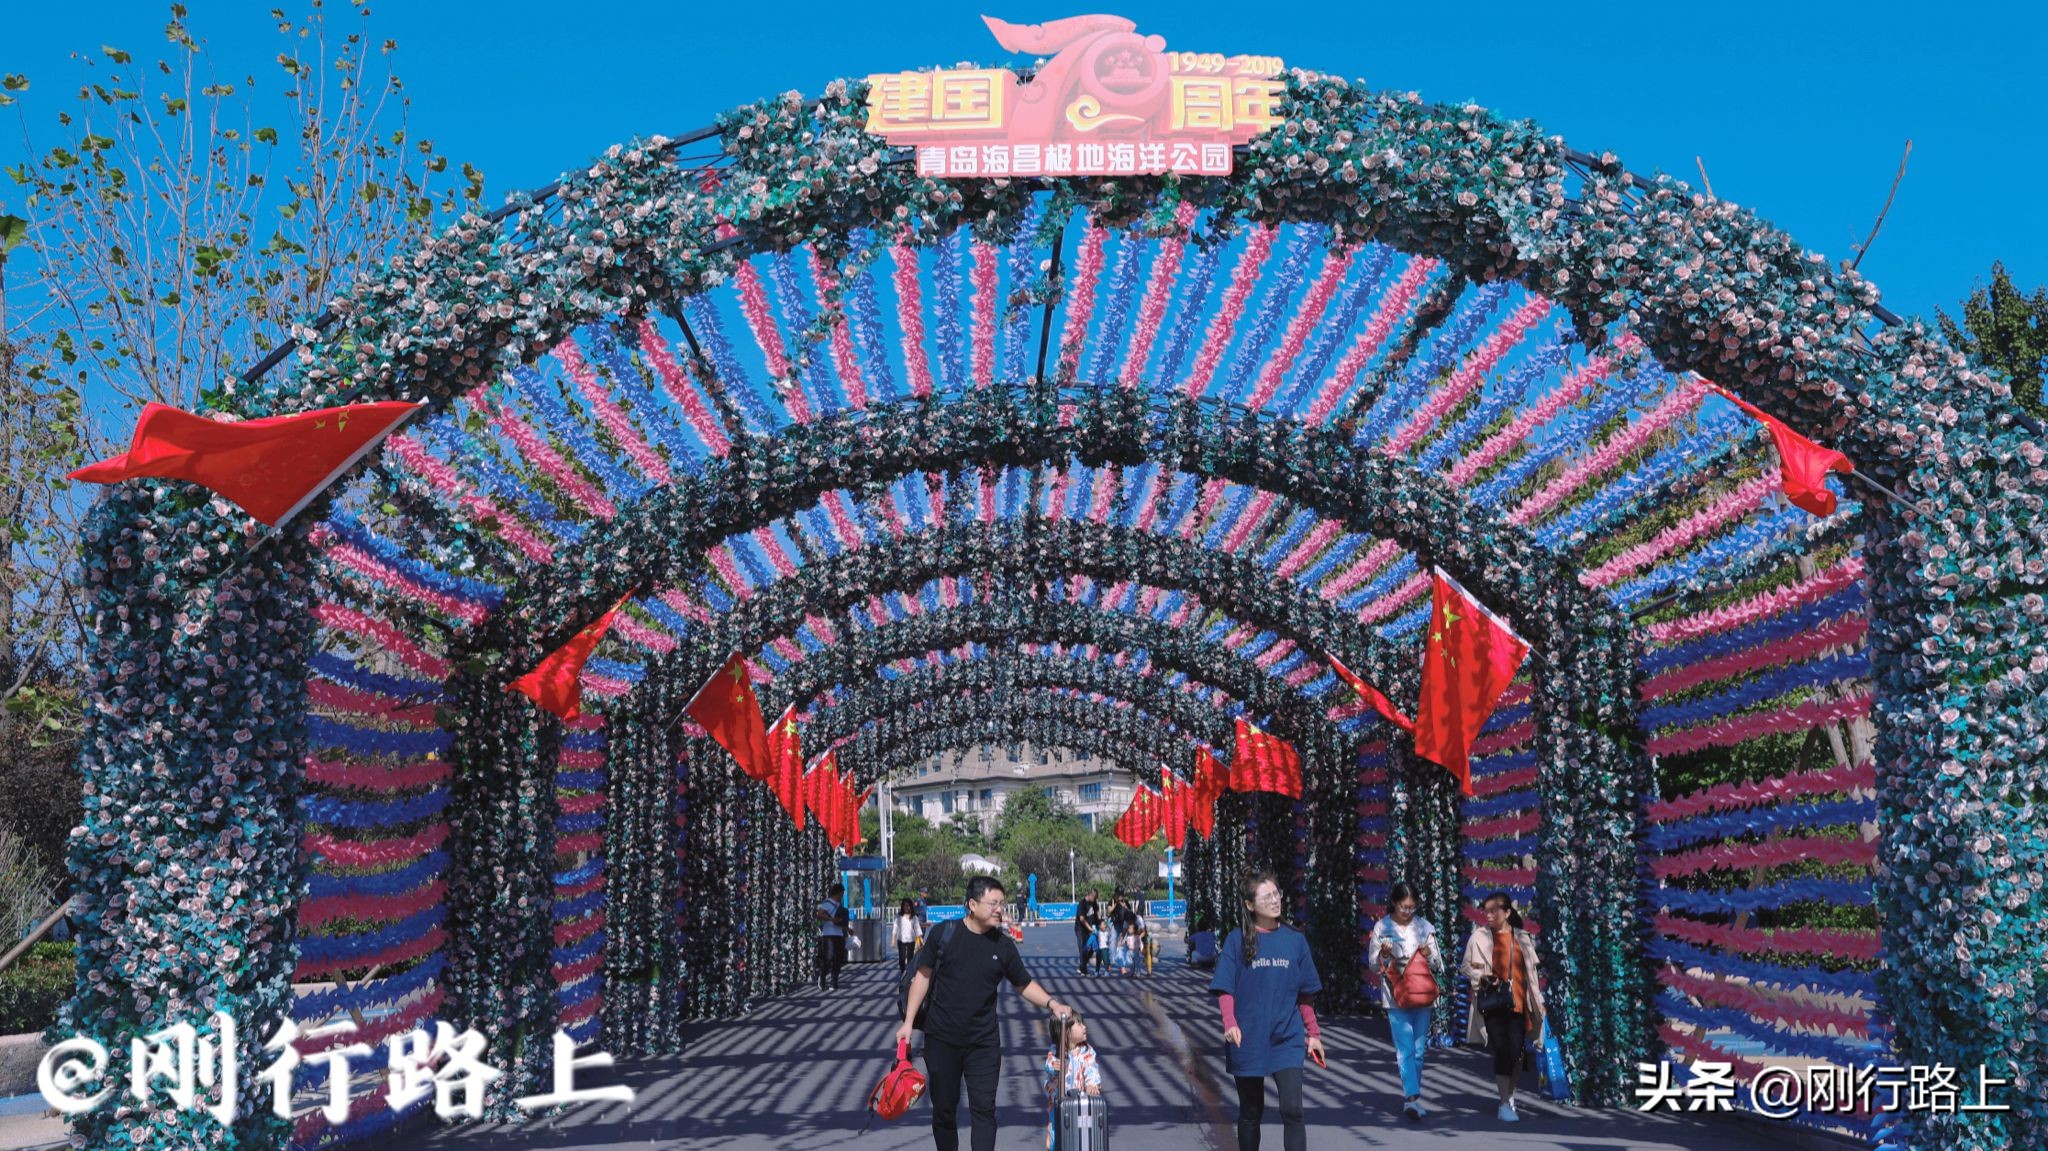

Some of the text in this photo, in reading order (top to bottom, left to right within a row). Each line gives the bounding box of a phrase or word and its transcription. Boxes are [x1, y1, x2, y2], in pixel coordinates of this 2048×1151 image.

[1168, 51, 1284, 76] 1949-2019
[864, 72, 1002, 132] 建国
[1169, 75, 1286, 132] 周年
[919, 143, 1229, 175] 青岛海昌极地海洋公园
